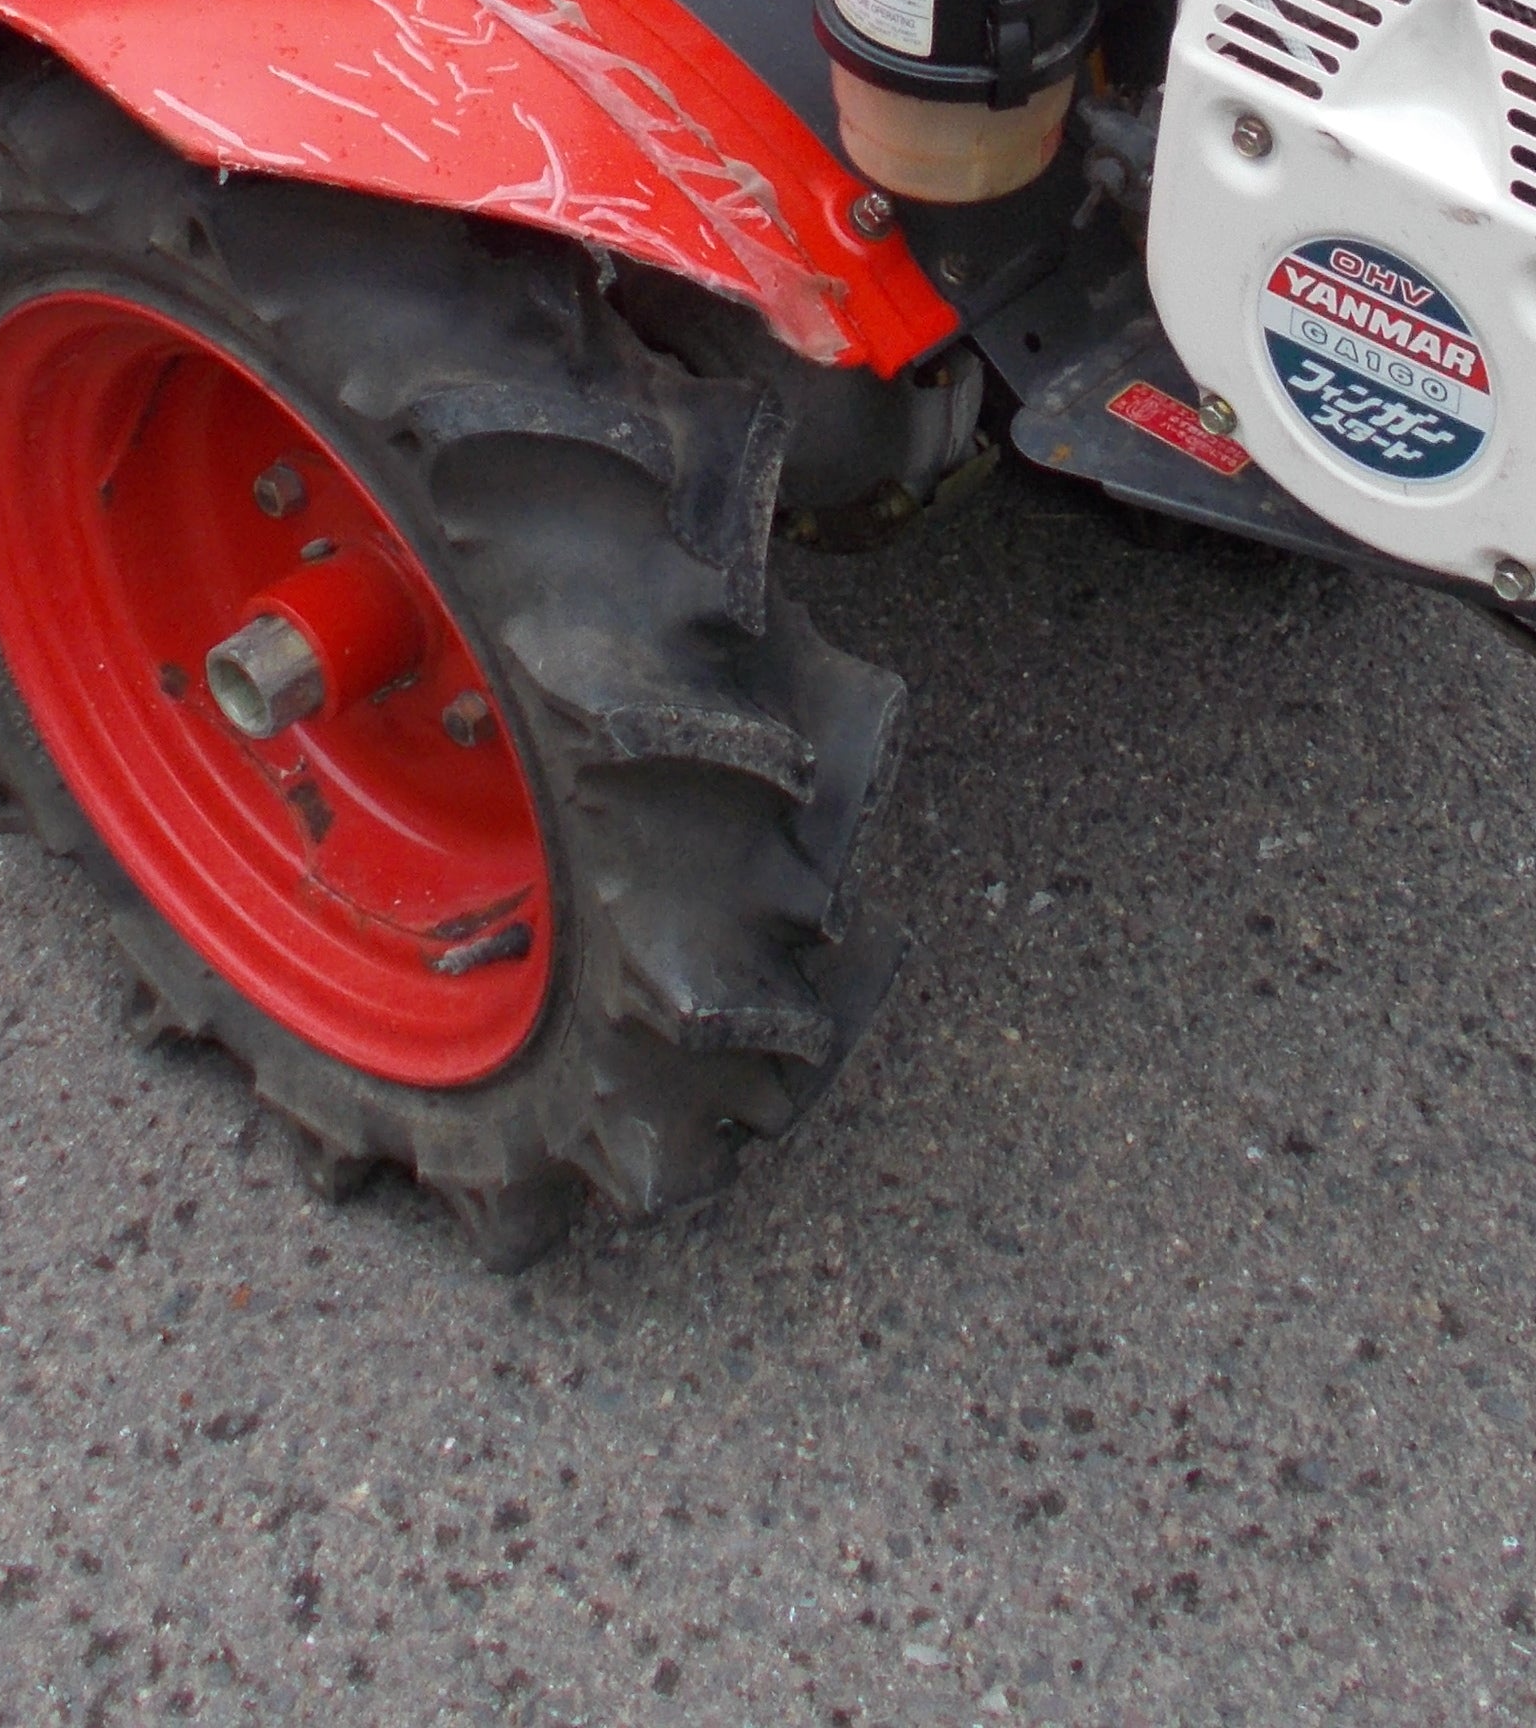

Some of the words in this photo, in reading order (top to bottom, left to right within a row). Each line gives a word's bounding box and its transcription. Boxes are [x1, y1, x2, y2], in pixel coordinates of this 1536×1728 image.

[1330, 248, 1435, 306] OHV
[1281, 265, 1478, 379] YANMAR
[1301, 318, 1450, 403] GA160
[1287, 360, 1456, 445] フィンガー
[1311, 406, 1425, 464] スタート
